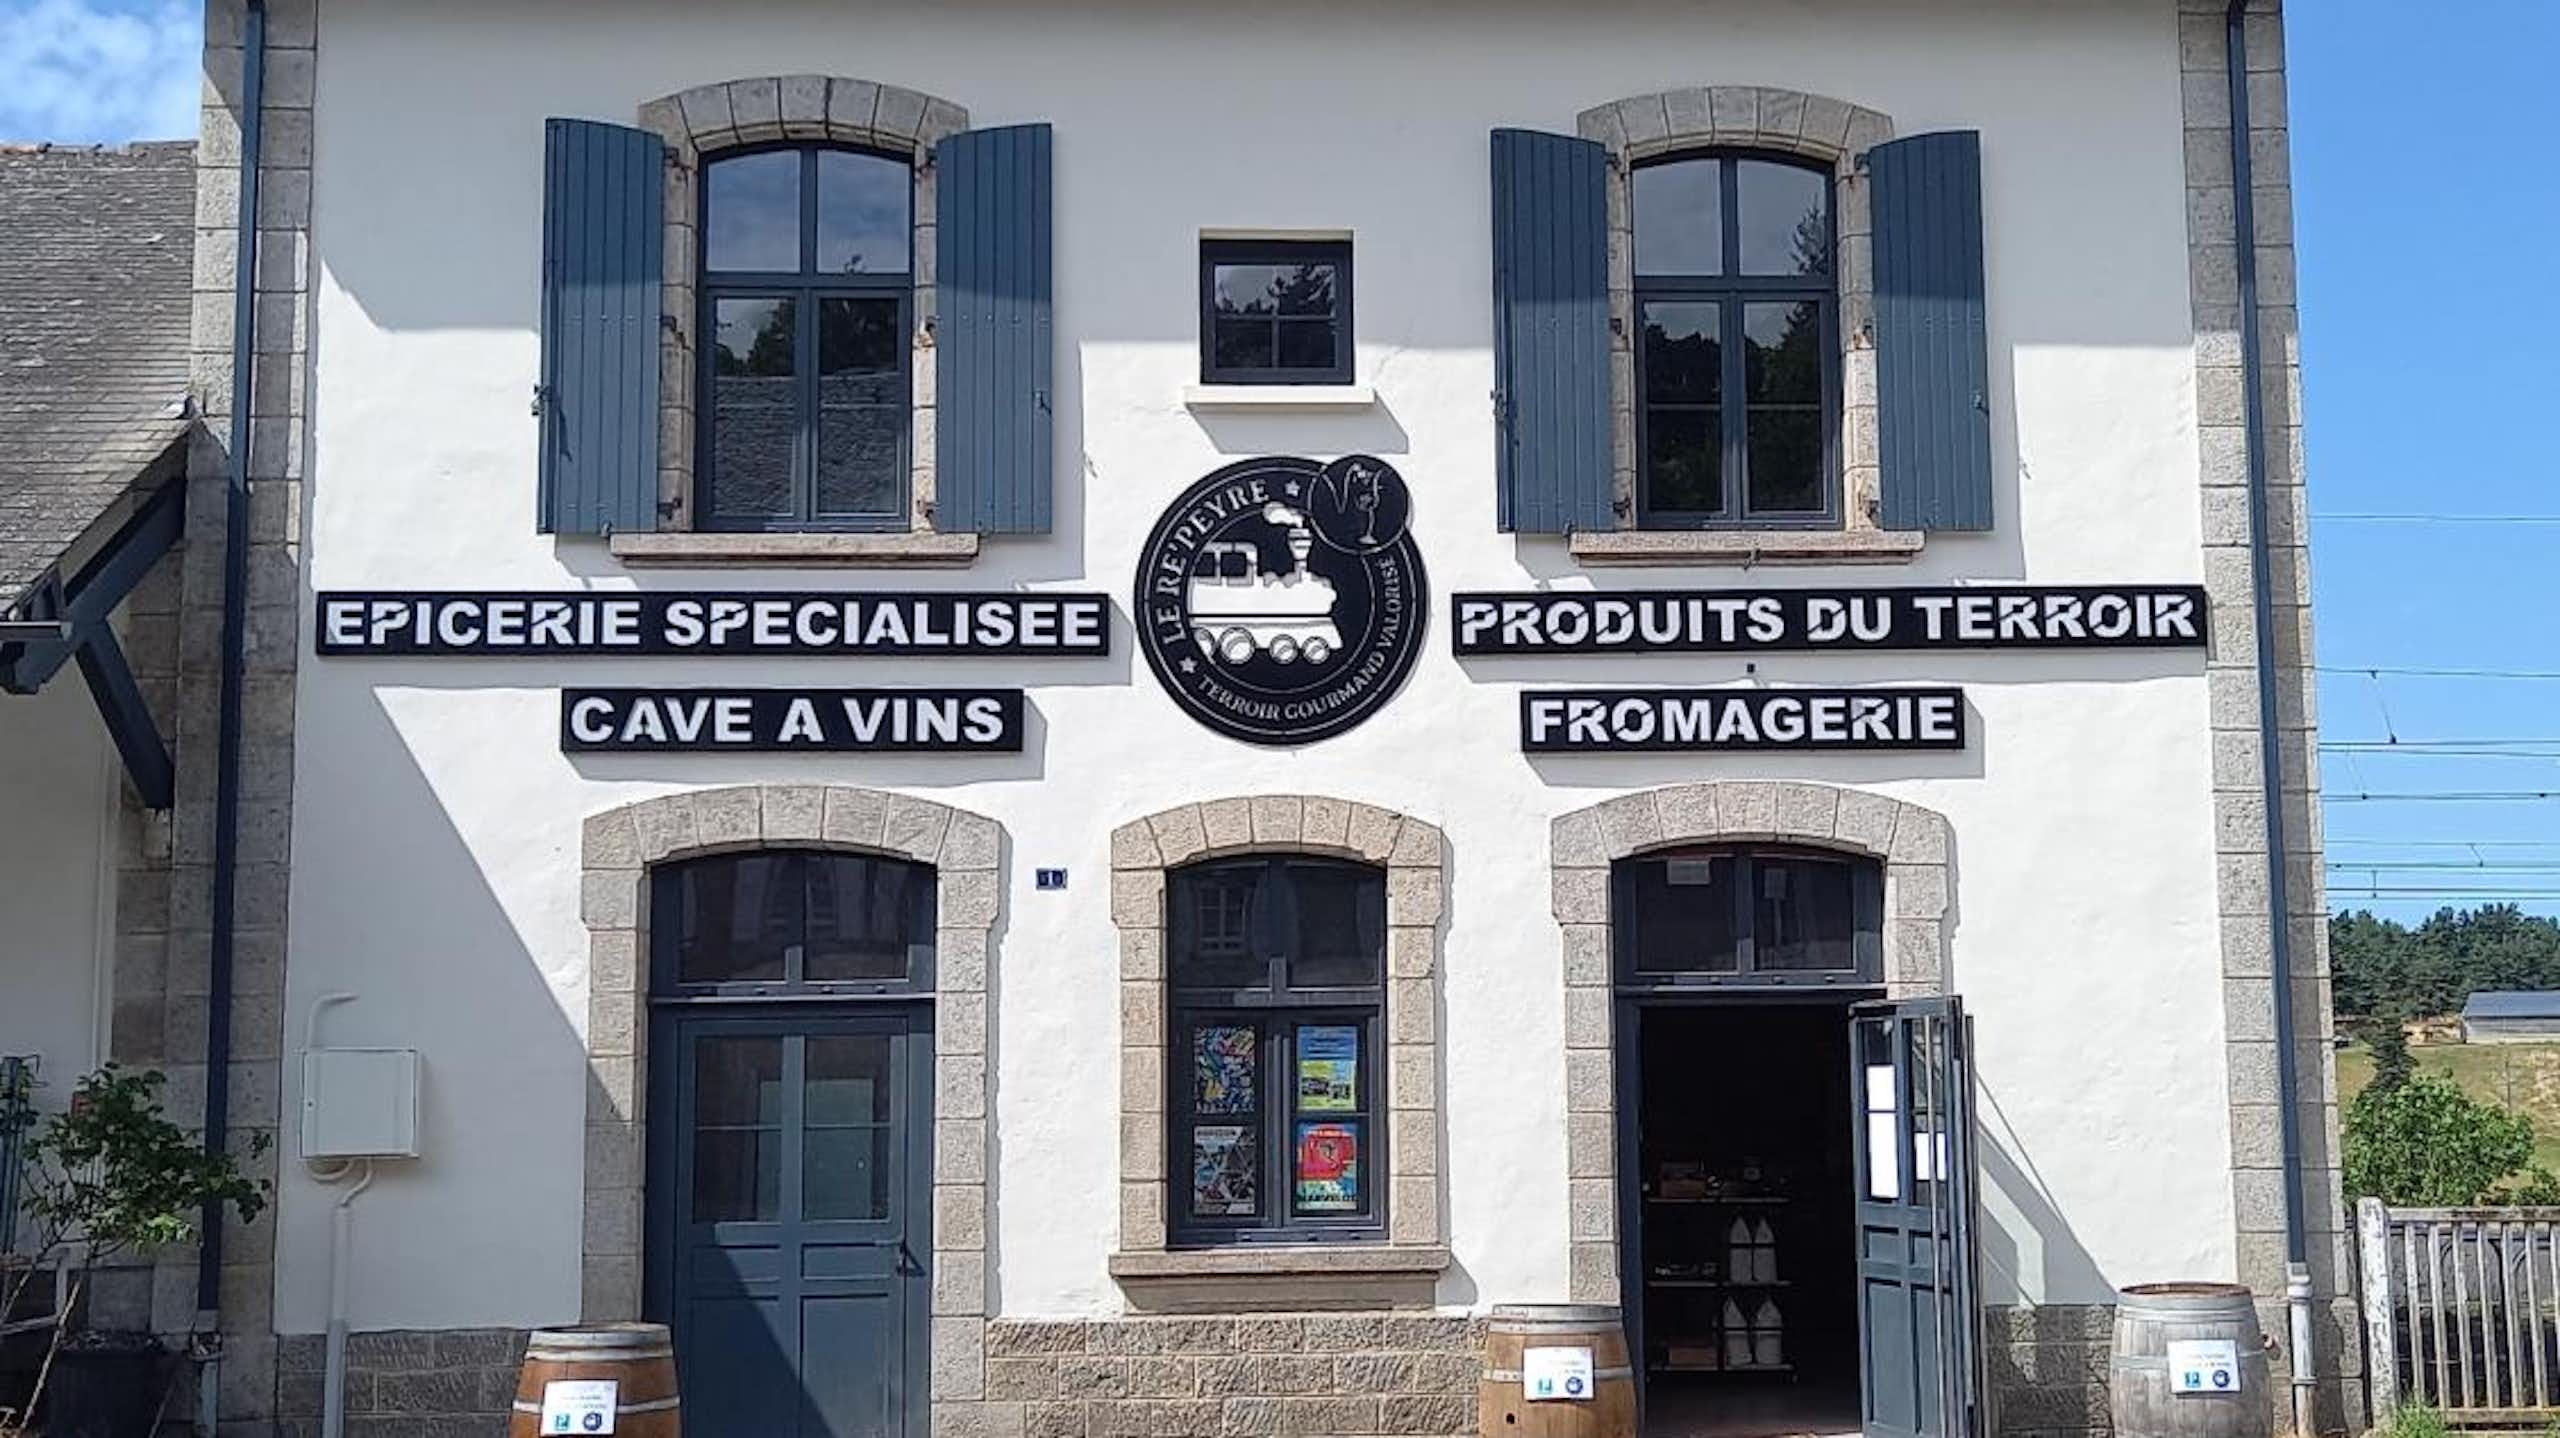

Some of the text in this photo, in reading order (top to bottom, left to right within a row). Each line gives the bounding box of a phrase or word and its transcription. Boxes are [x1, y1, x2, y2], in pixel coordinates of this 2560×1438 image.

[326, 601, 1101, 647] EPICERIE SPECIALISEE
[1155, 604, 1187, 645] LE
[1460, 595, 2197, 646] PRODUITS DU TERROIR
[1197, 674, 1281, 721] TERROIR
[1284, 650, 1386, 720] GOURMAND
[571, 698, 1004, 742] CAVE A VINS
[1529, 697, 1957, 743] FROMAGERIE
